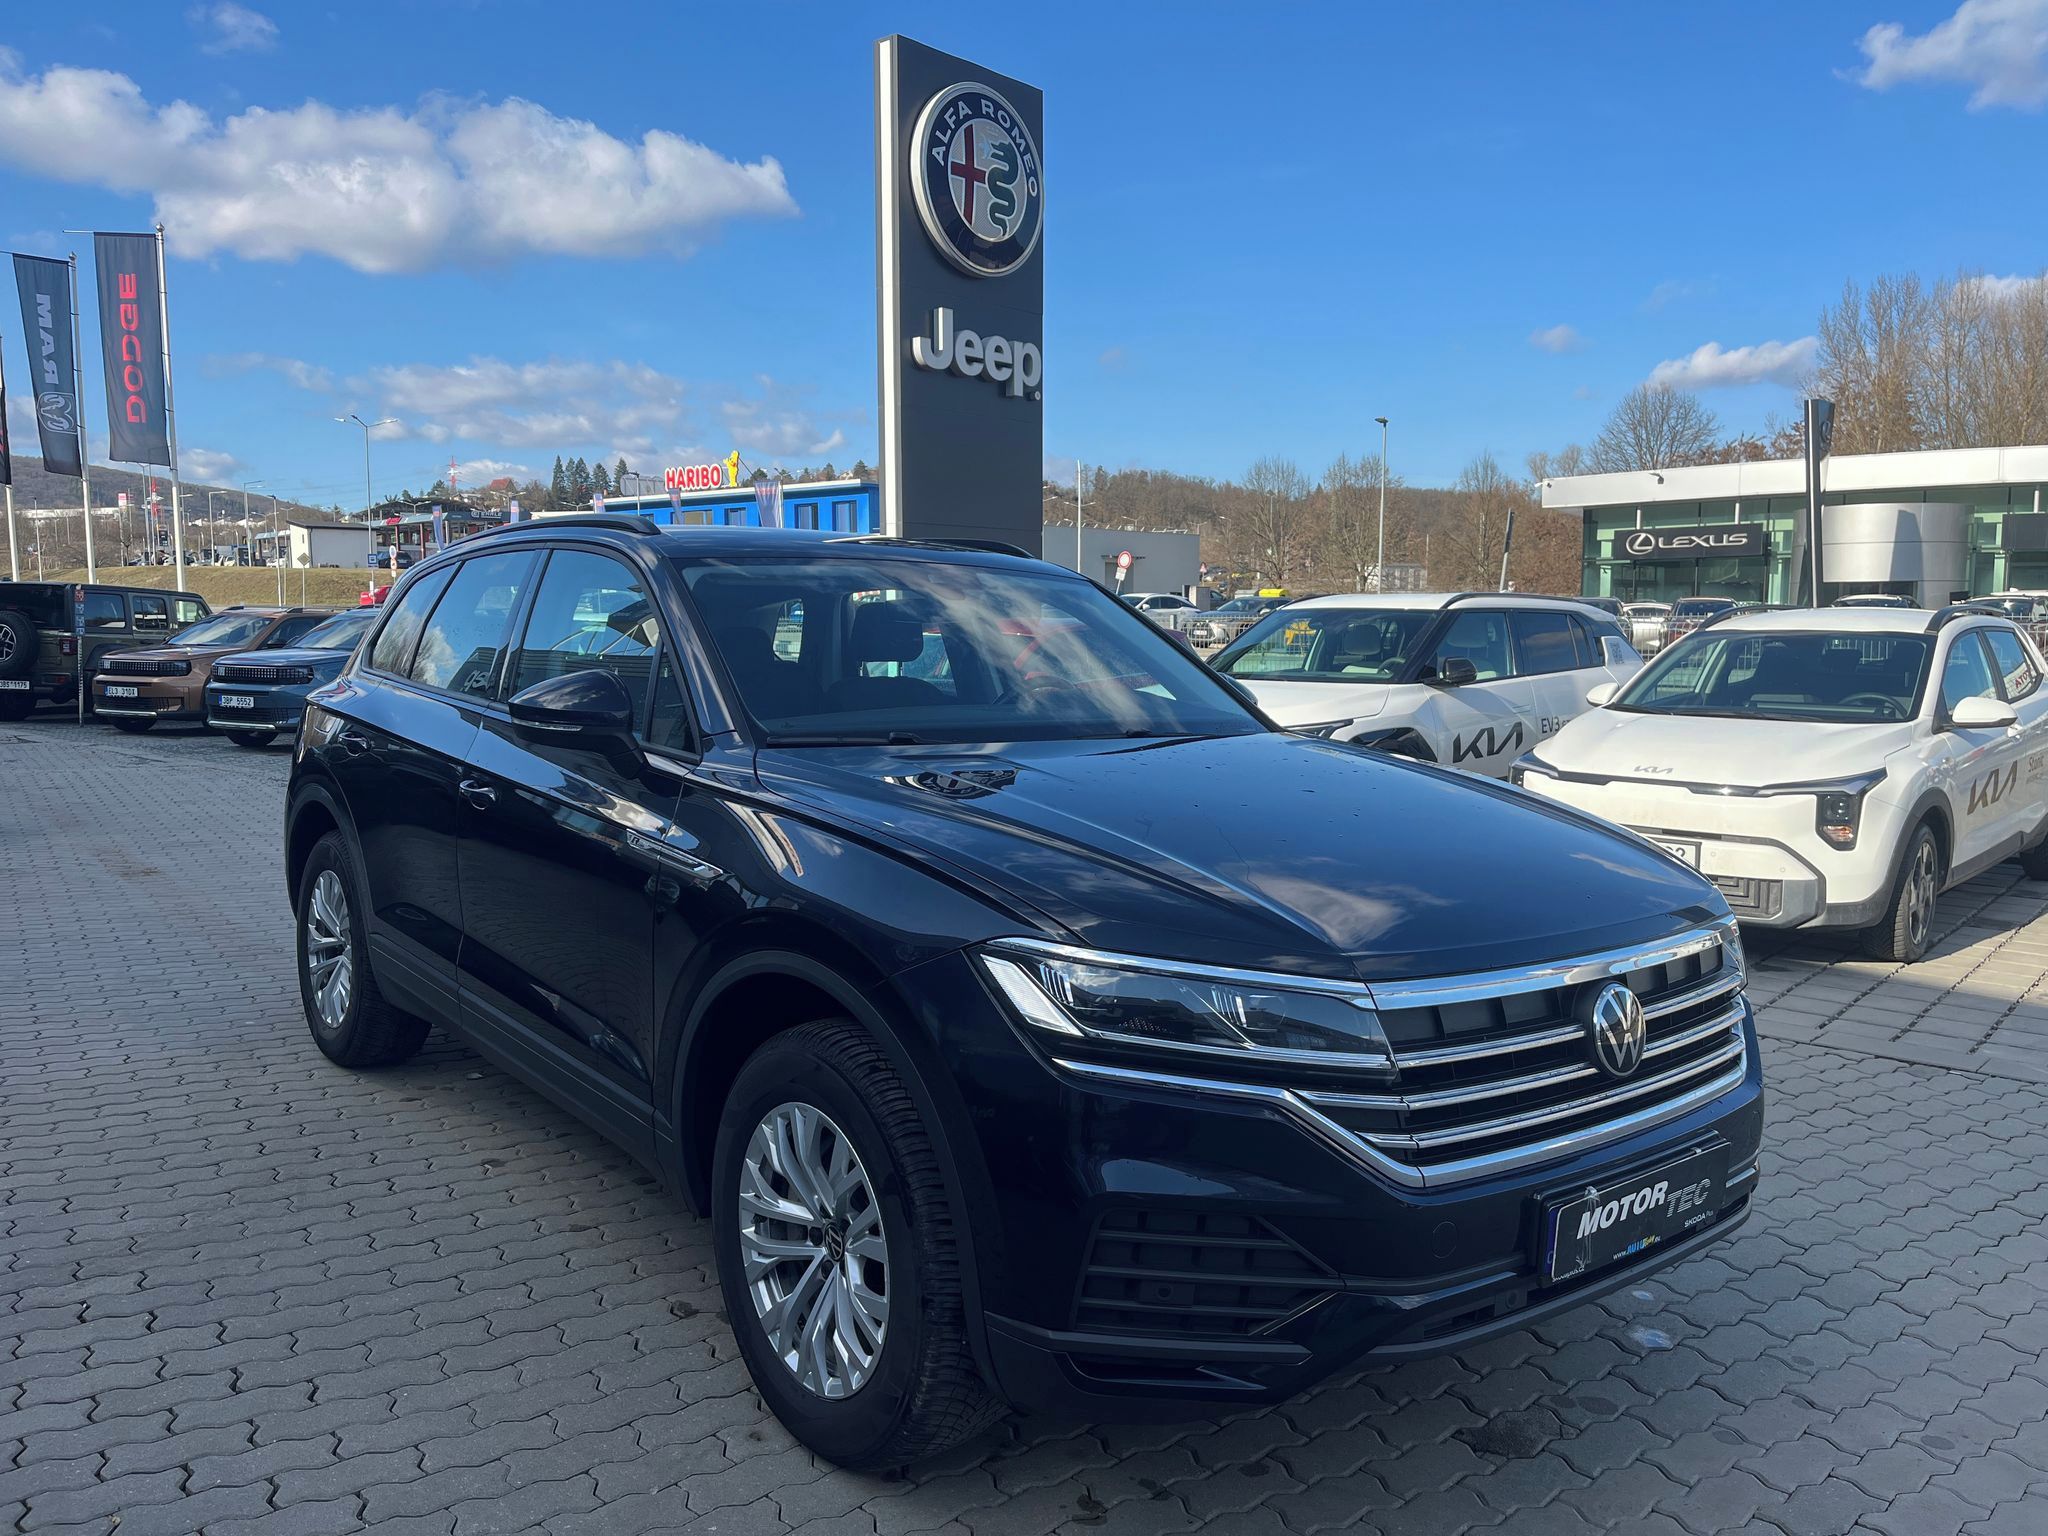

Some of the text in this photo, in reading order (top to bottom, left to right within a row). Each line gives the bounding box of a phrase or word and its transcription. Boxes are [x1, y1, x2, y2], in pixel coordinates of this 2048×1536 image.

[932, 99, 1038, 198] ALFA ROMEO
[912, 306, 1042, 398] Jeep
[665, 463, 722, 489] HARIBO
[1658, 532, 1748, 549] LEXUS
[1540, 715, 1561, 734] EV3
[1452, 721, 1524, 764] KIA
